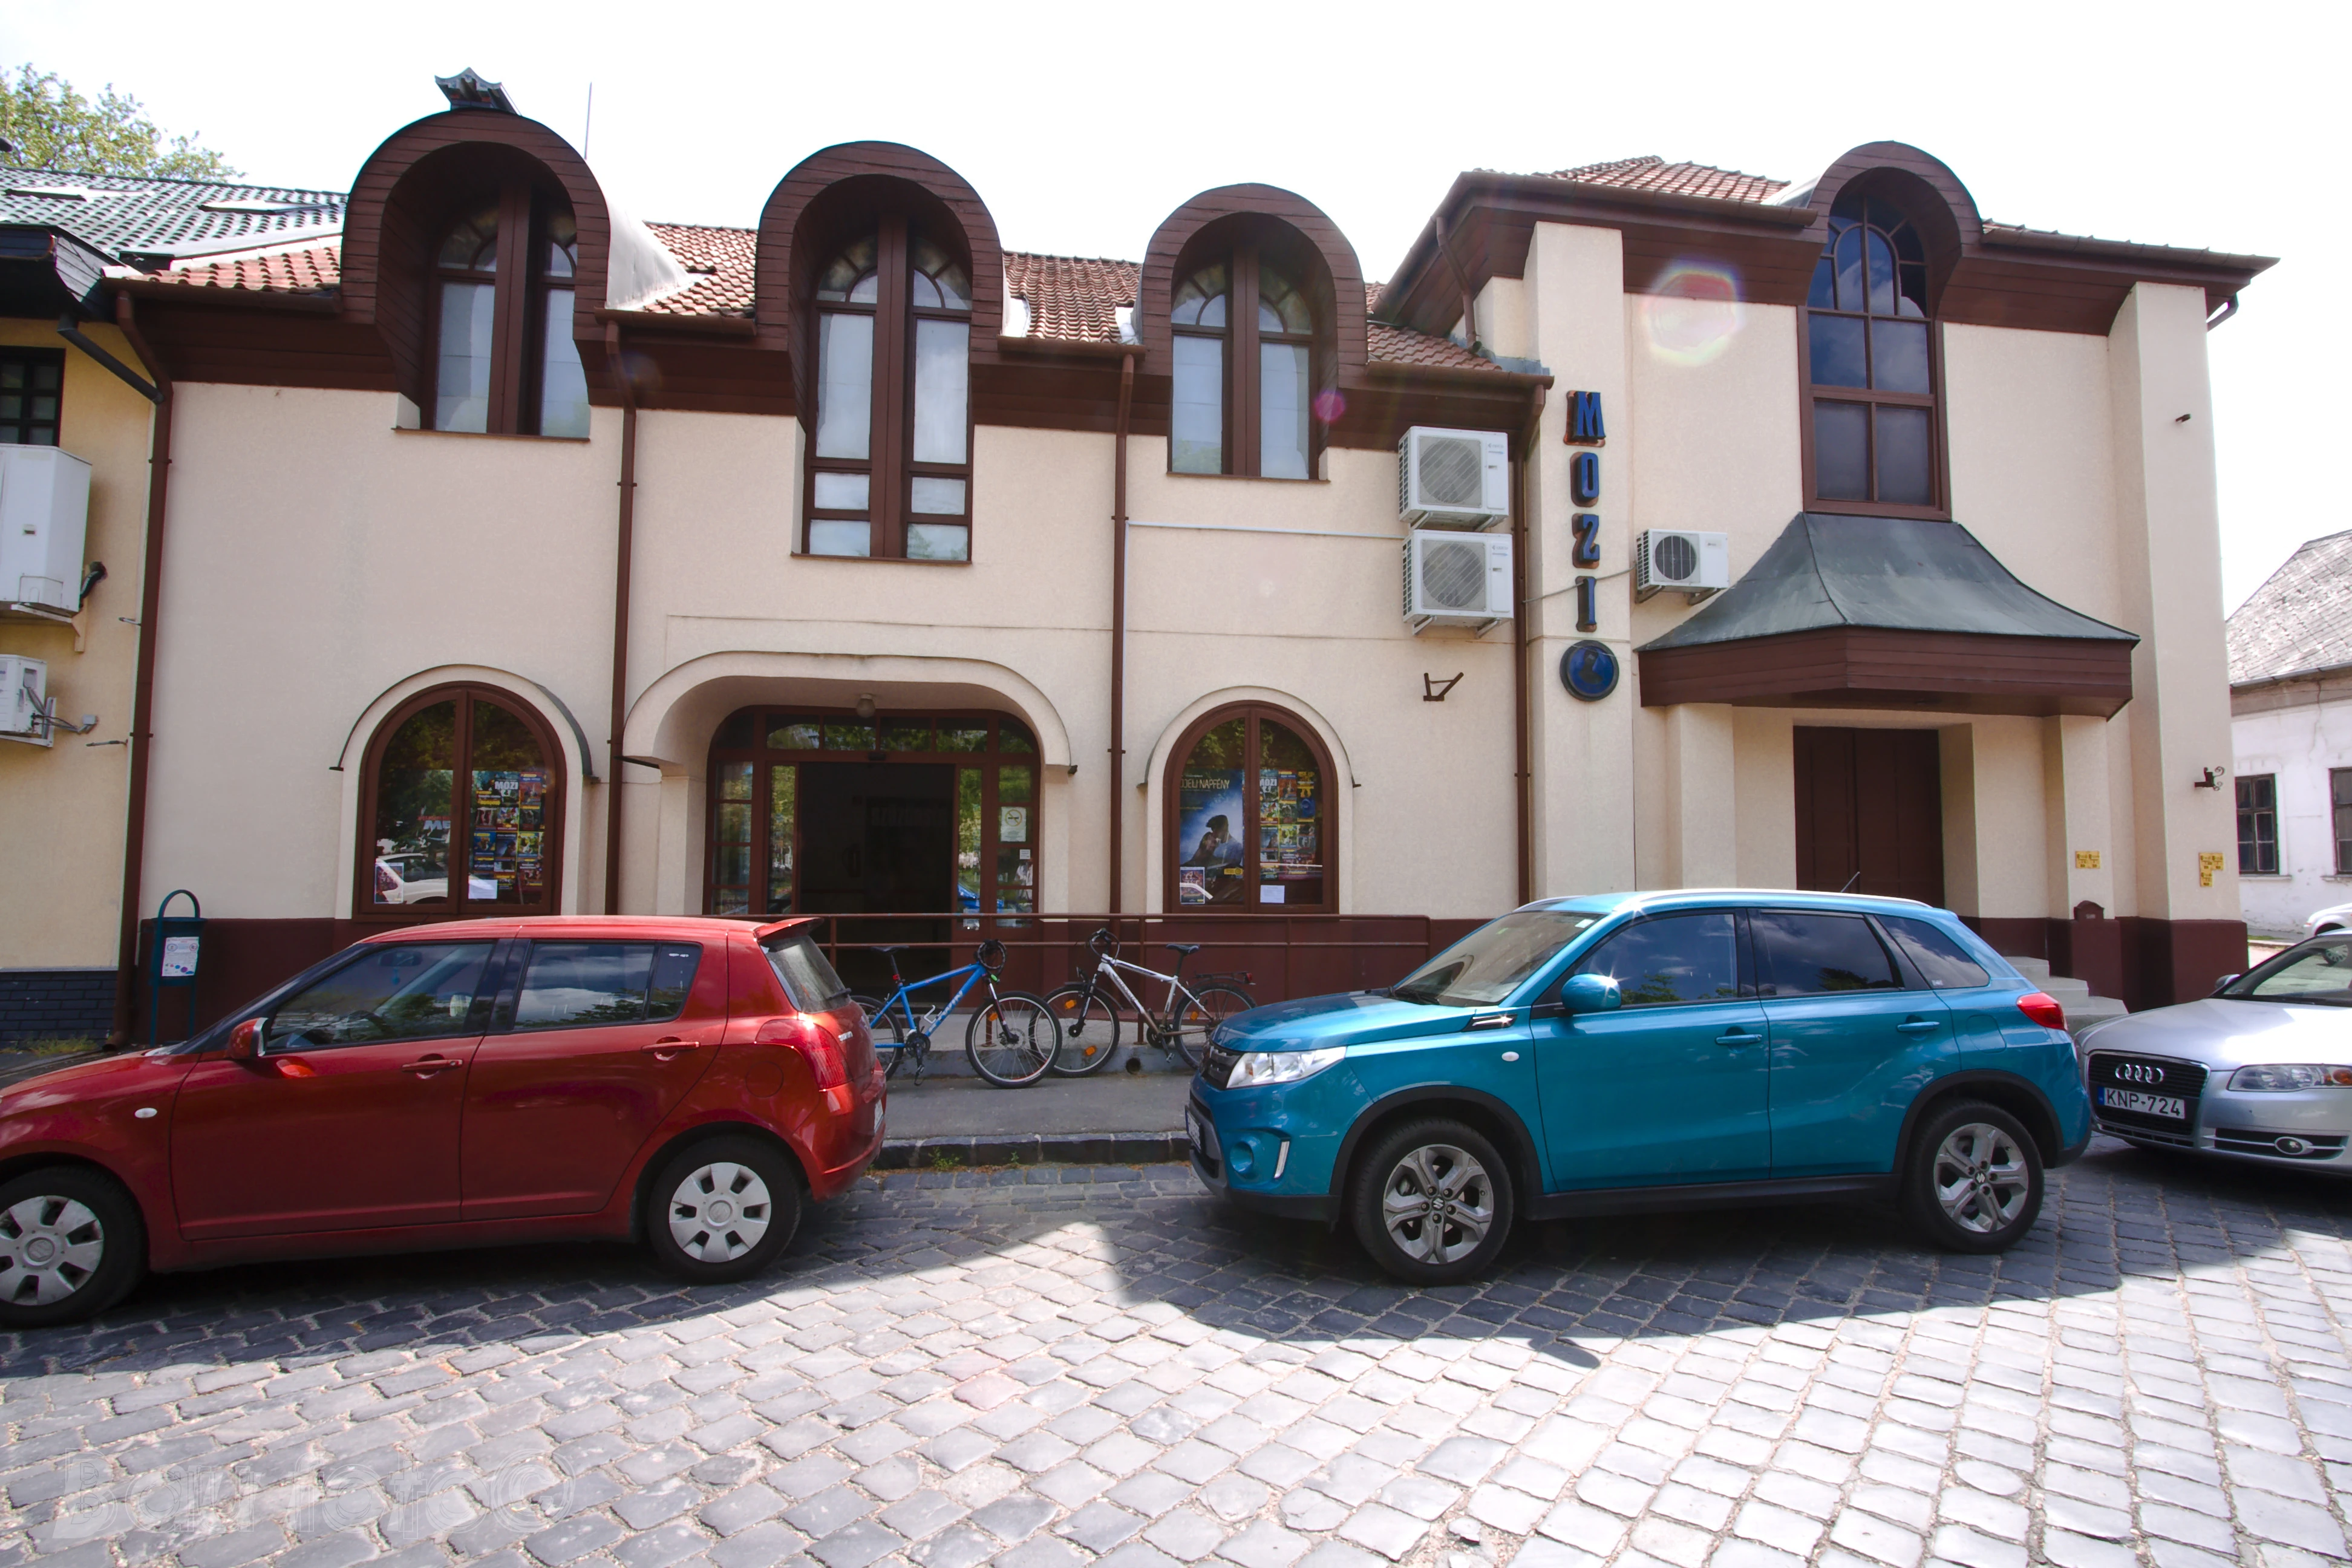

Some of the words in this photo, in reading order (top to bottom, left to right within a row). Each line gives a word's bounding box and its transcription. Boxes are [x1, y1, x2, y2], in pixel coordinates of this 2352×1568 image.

[1565, 390, 1606, 631] MOZI
[494, 781, 518, 789] MOZI
[1200, 778, 1230, 789] NAPFÉNY
[2106, 1089, 2180, 1116] KNP-724
